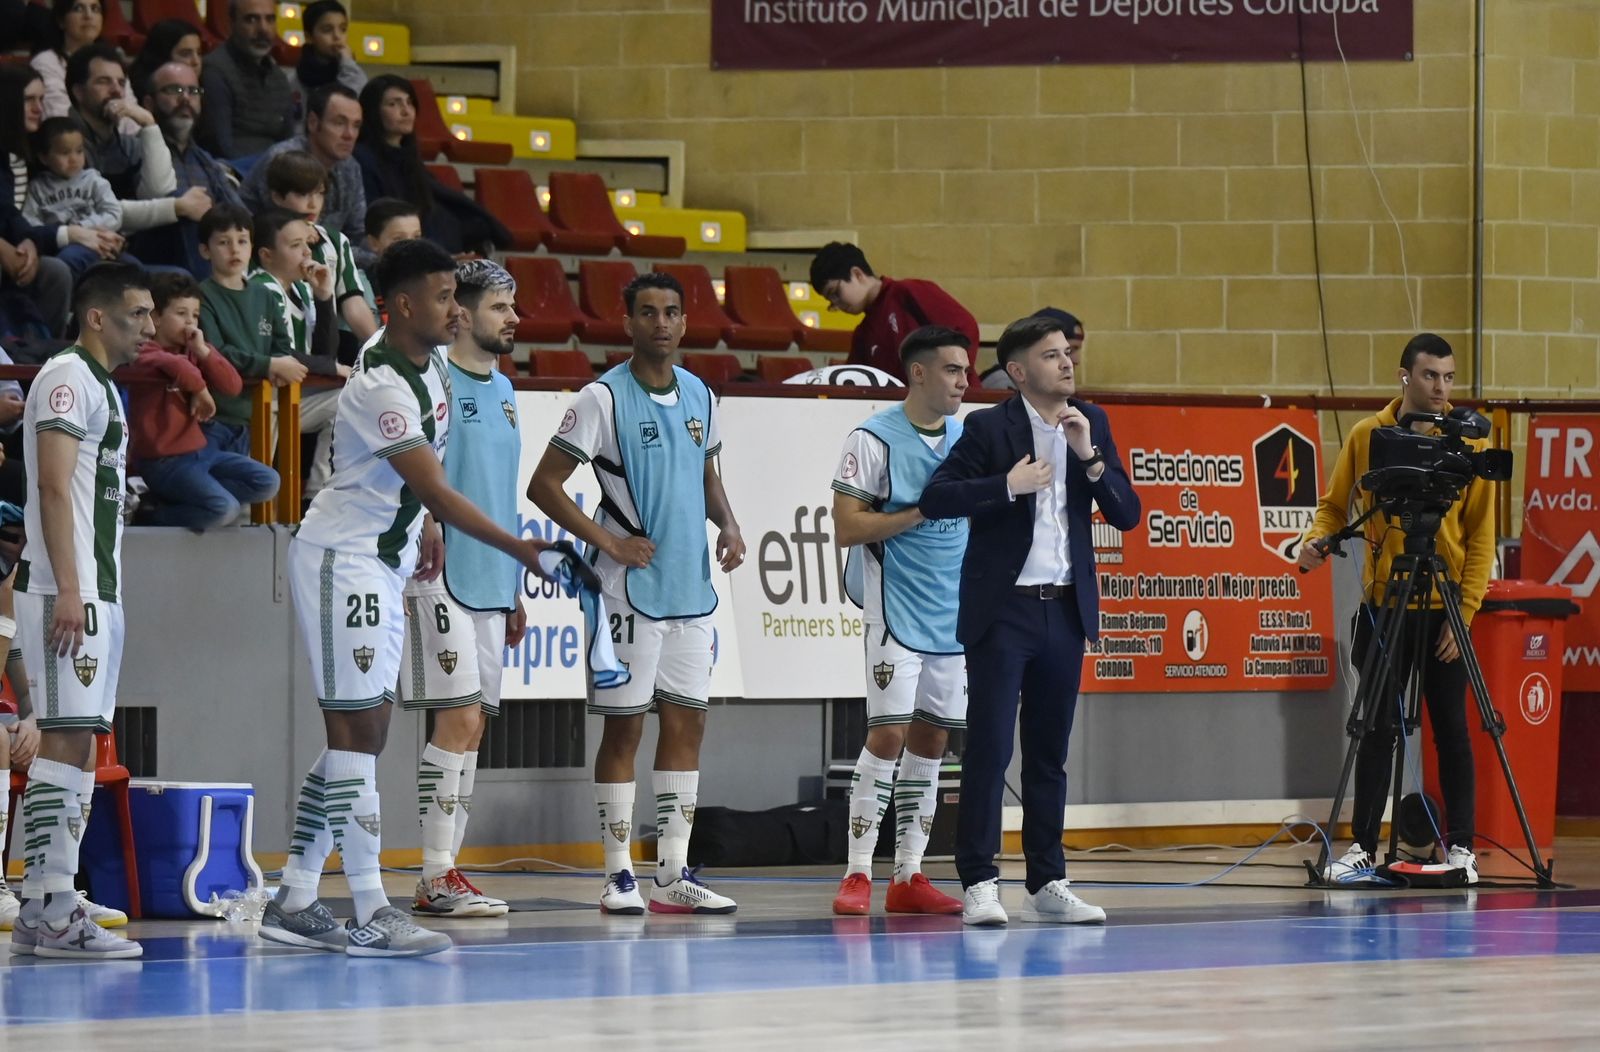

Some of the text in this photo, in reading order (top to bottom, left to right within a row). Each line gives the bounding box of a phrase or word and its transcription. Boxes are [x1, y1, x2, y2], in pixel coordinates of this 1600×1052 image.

[744, 0, 867, 23] Instituto
[876, 0, 1029, 27] Municipal
[1039, 0, 1077, 18] de
[1089, 0, 1234, 24] Deportes
[1131, 451, 1242, 484] Estaciones
[1535, 428, 1593, 478] TR
[1274, 437, 1299, 501] 4
[1181, 489, 1198, 509] de
[1527, 488, 1598, 511] Avda.
[1149, 513, 1233, 544] Servicio
[1264, 510, 1315, 529] RUTA
[1100, 573, 1299, 600] Mejor Carburante al Mejor precio.
[346, 593, 380, 628] 25
[434, 602, 450, 634] 6
[762, 612, 836, 637] Partners
[609, 612, 635, 644] 21
